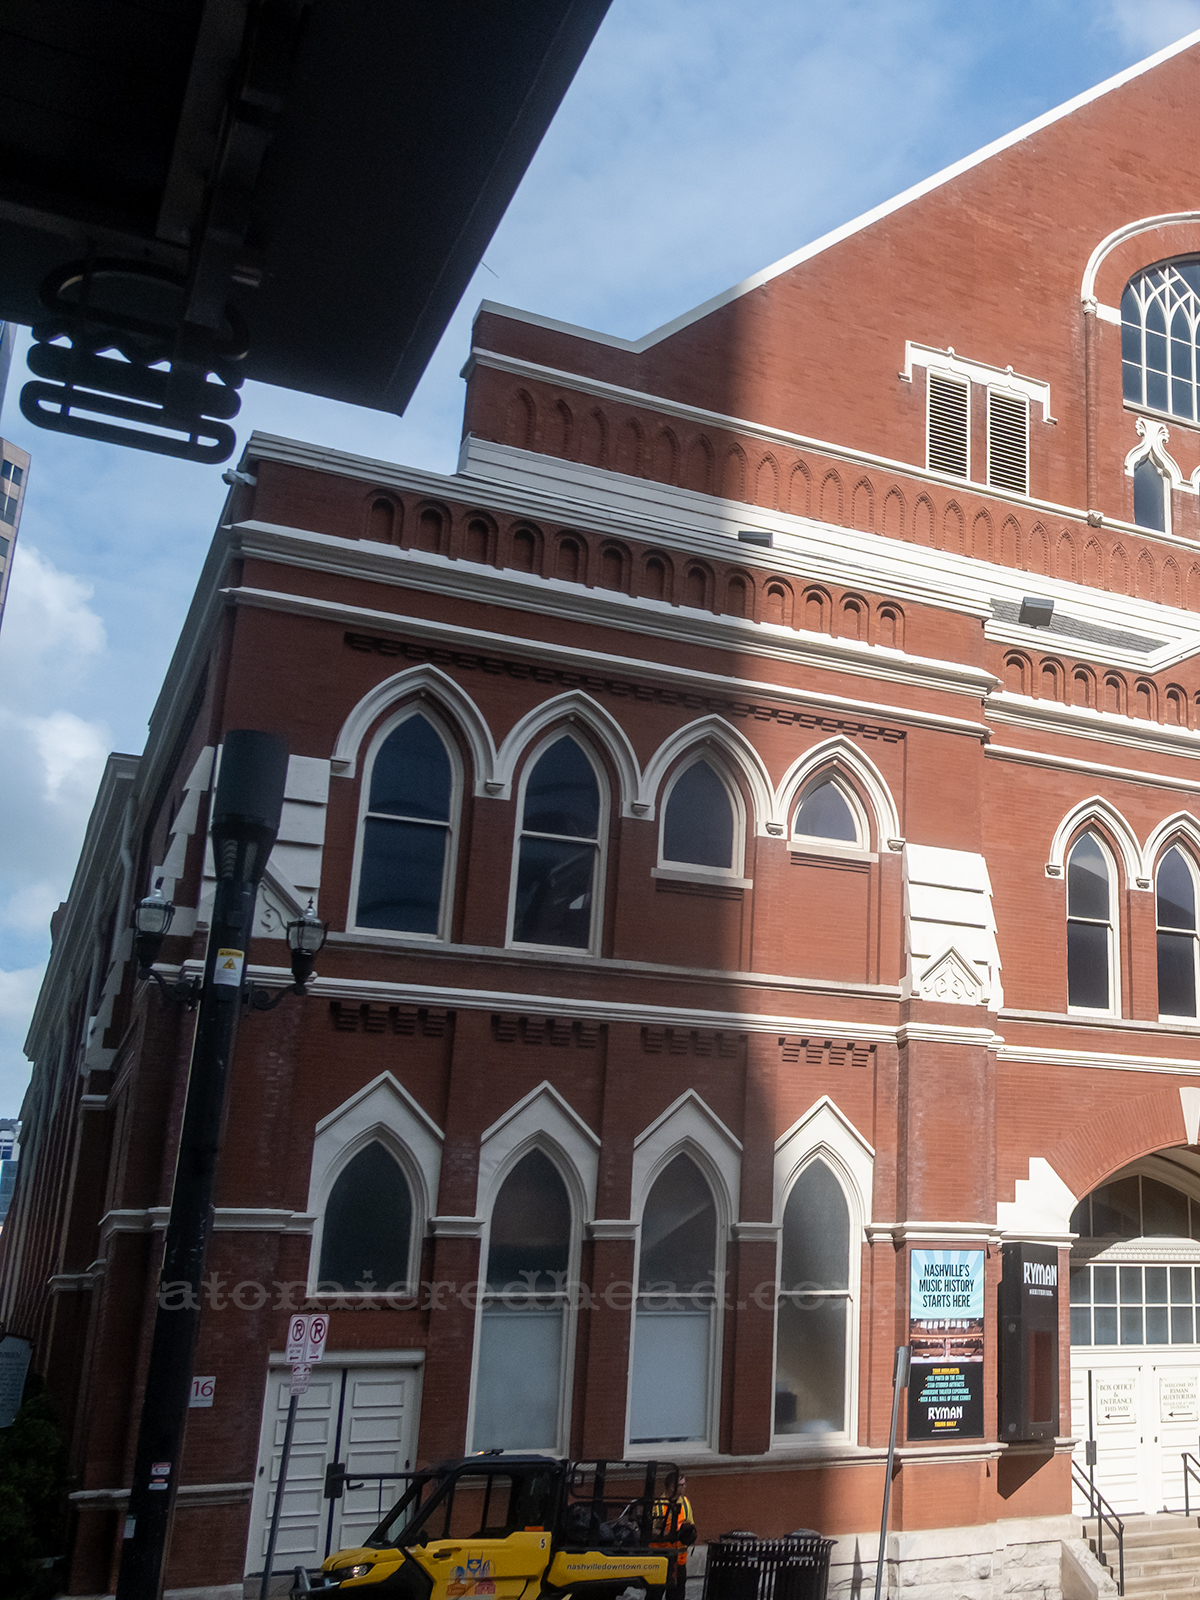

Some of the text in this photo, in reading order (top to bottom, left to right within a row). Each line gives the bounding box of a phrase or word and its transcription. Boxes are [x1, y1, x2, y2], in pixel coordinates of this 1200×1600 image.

[924, 1264, 970, 1277] NASHVILLE'S
[1023, 1262, 1058, 1287] RYMAN
[919, 1279, 975, 1292] MUSIC HISTORY
[922, 1294, 971, 1308] STARTS HERE
[193, 1380, 213, 1397] 16
[927, 1405, 963, 1420] RYMAN
[540, 1539, 546, 1549] 5
[566, 1562, 660, 1571] nashvilledowntown.com
